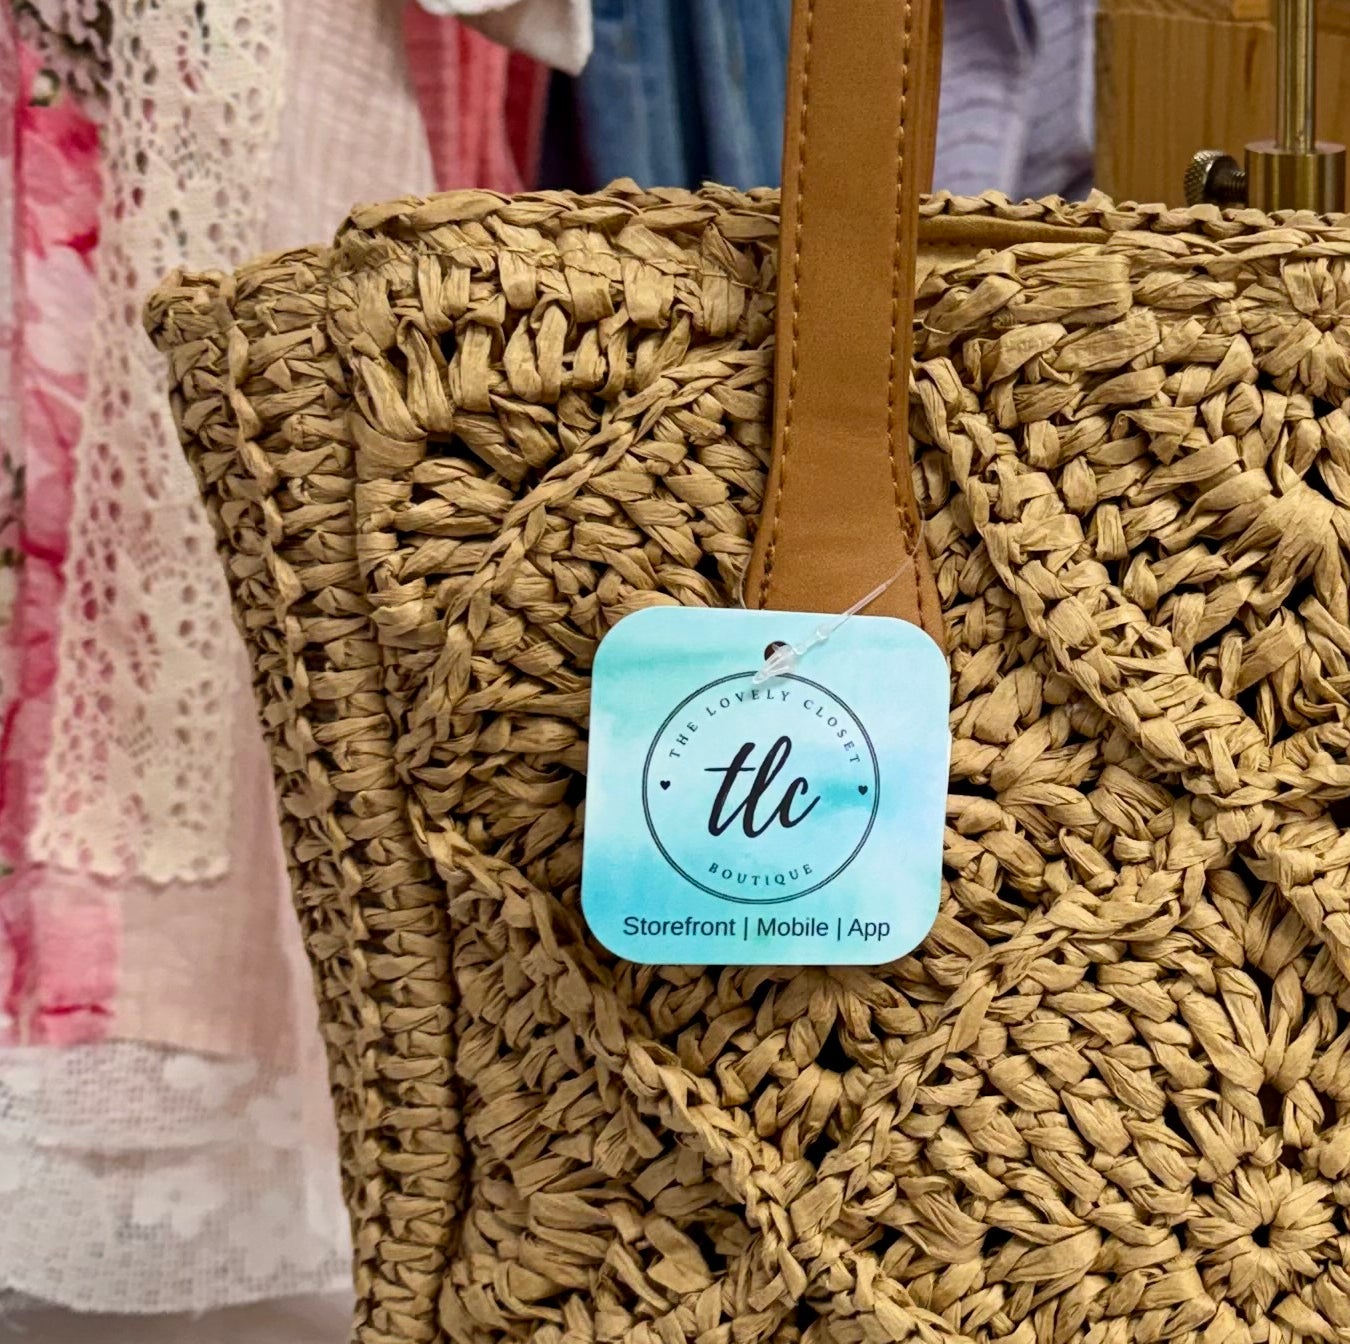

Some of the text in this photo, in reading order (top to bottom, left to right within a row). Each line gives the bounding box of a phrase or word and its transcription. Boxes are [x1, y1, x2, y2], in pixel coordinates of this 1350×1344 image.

[669, 689, 862, 764] THE LOVELY CLOSET
[704, 735, 821, 838] tlc
[708, 862, 814, 886] BOUTIQUE
[623, 916, 736, 937] Storefront
[757, 917, 829, 938] Mobile
[848, 918, 891, 941] App
